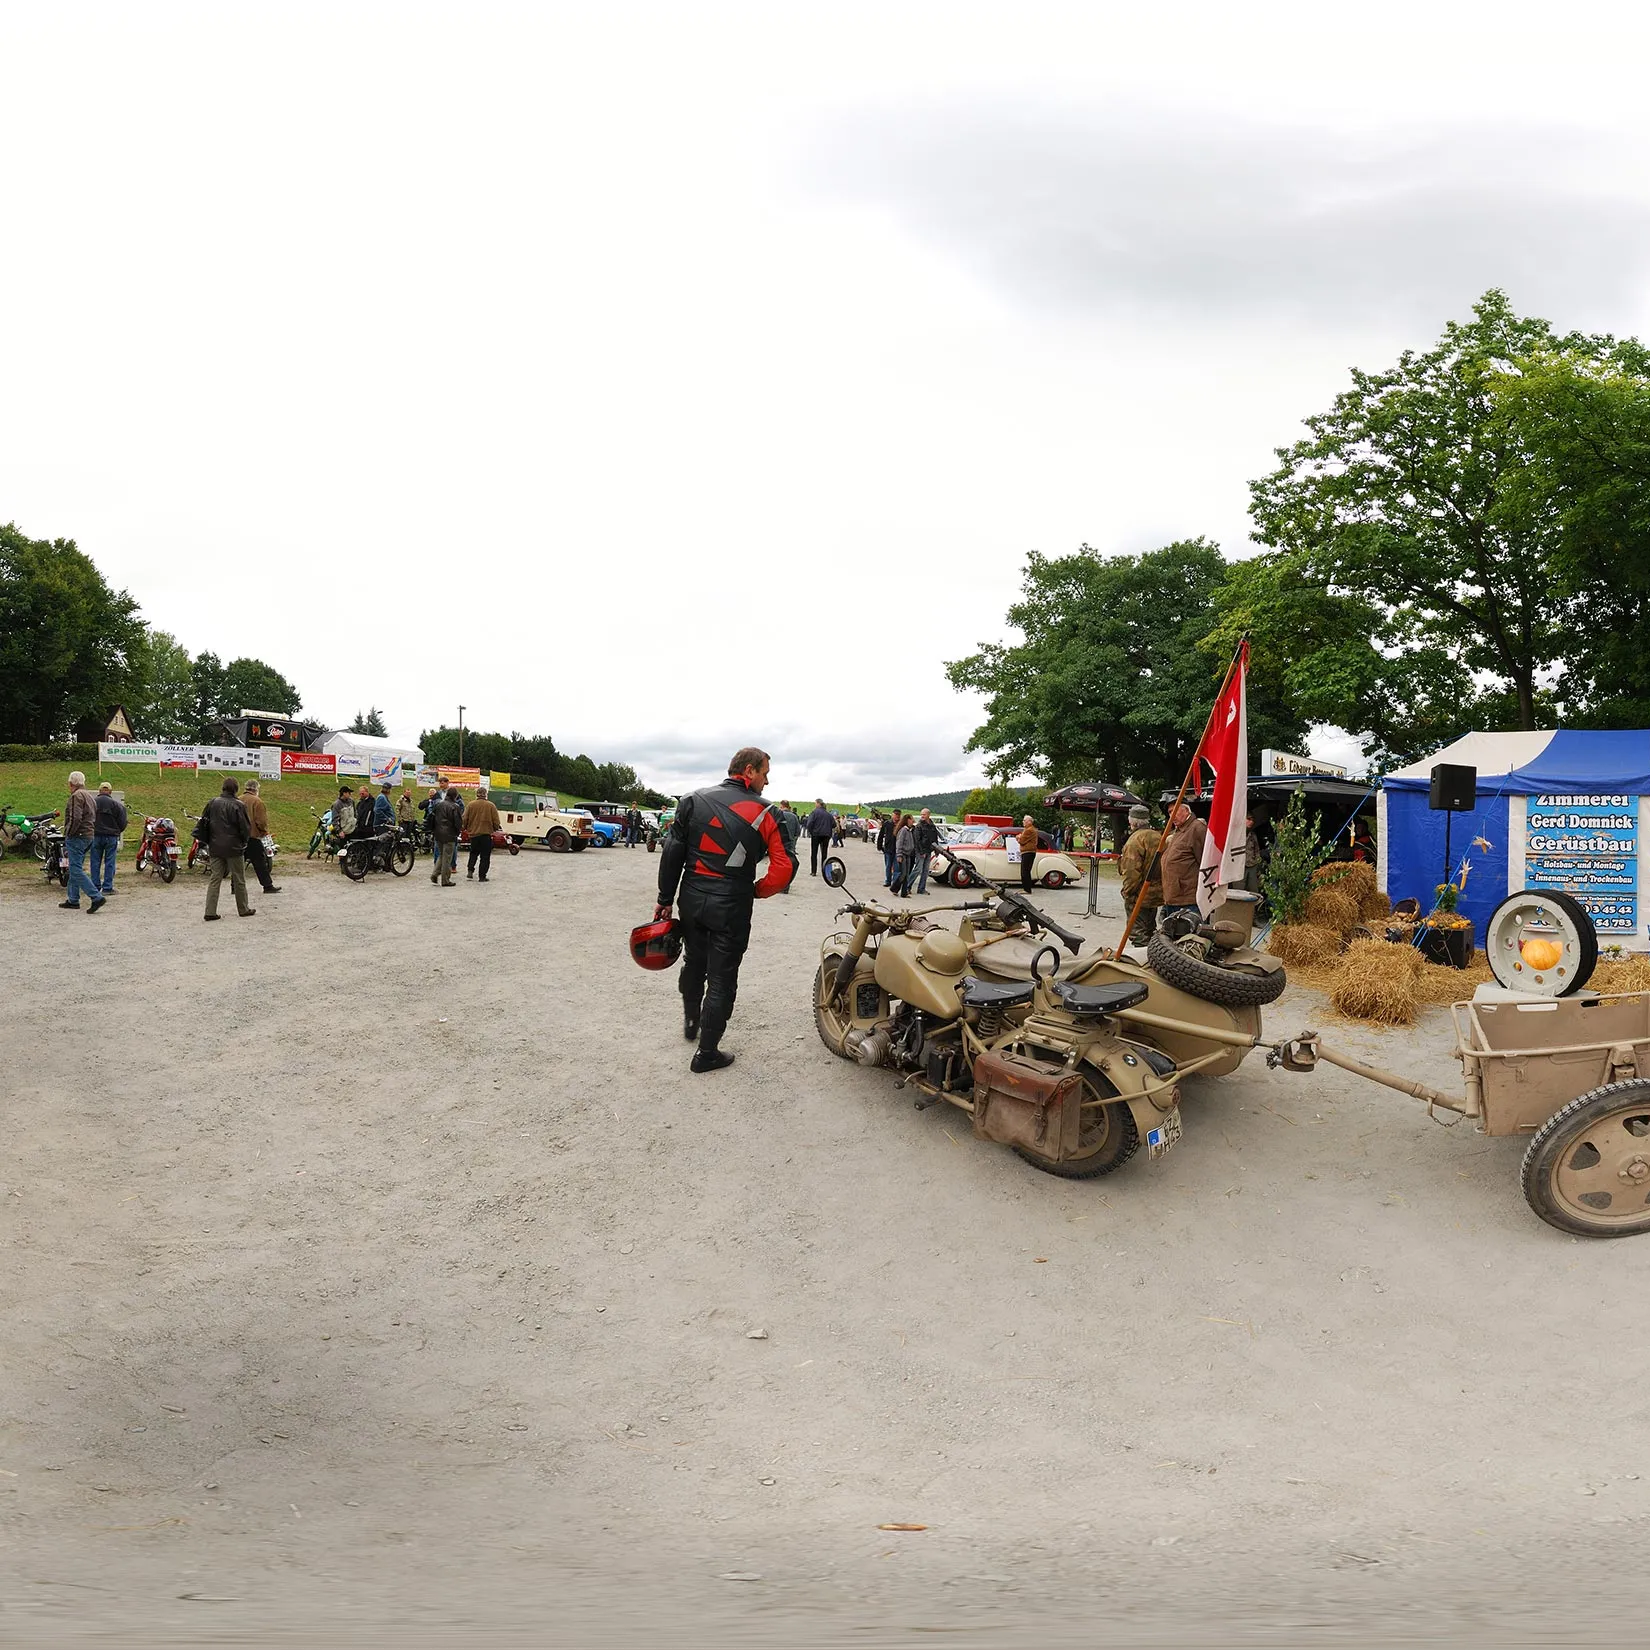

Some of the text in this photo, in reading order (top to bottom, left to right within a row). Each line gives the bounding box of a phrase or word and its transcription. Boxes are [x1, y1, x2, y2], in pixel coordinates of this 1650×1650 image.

[107, 748, 157, 756] SPEDITION
[1536, 794, 1629, 807] Zimmerei
[1531, 814, 1633, 829] Gerd Domnick
[1530, 836, 1633, 852] Gerüstbau
[1543, 861, 1576, 869] Holzbau-
[1577, 861, 1592, 869] und
[1593, 862, 1625, 871] Montage
[1535, 874, 1572, 882] Innenaus-
[1589, 875, 1633, 883] Trockenbau
[1592, 905, 1600, 913] 3
[1602, 905, 1616, 914] 45
[1618, 906, 1632, 914] 42
[1595, 919, 1632, 927] 54 783
